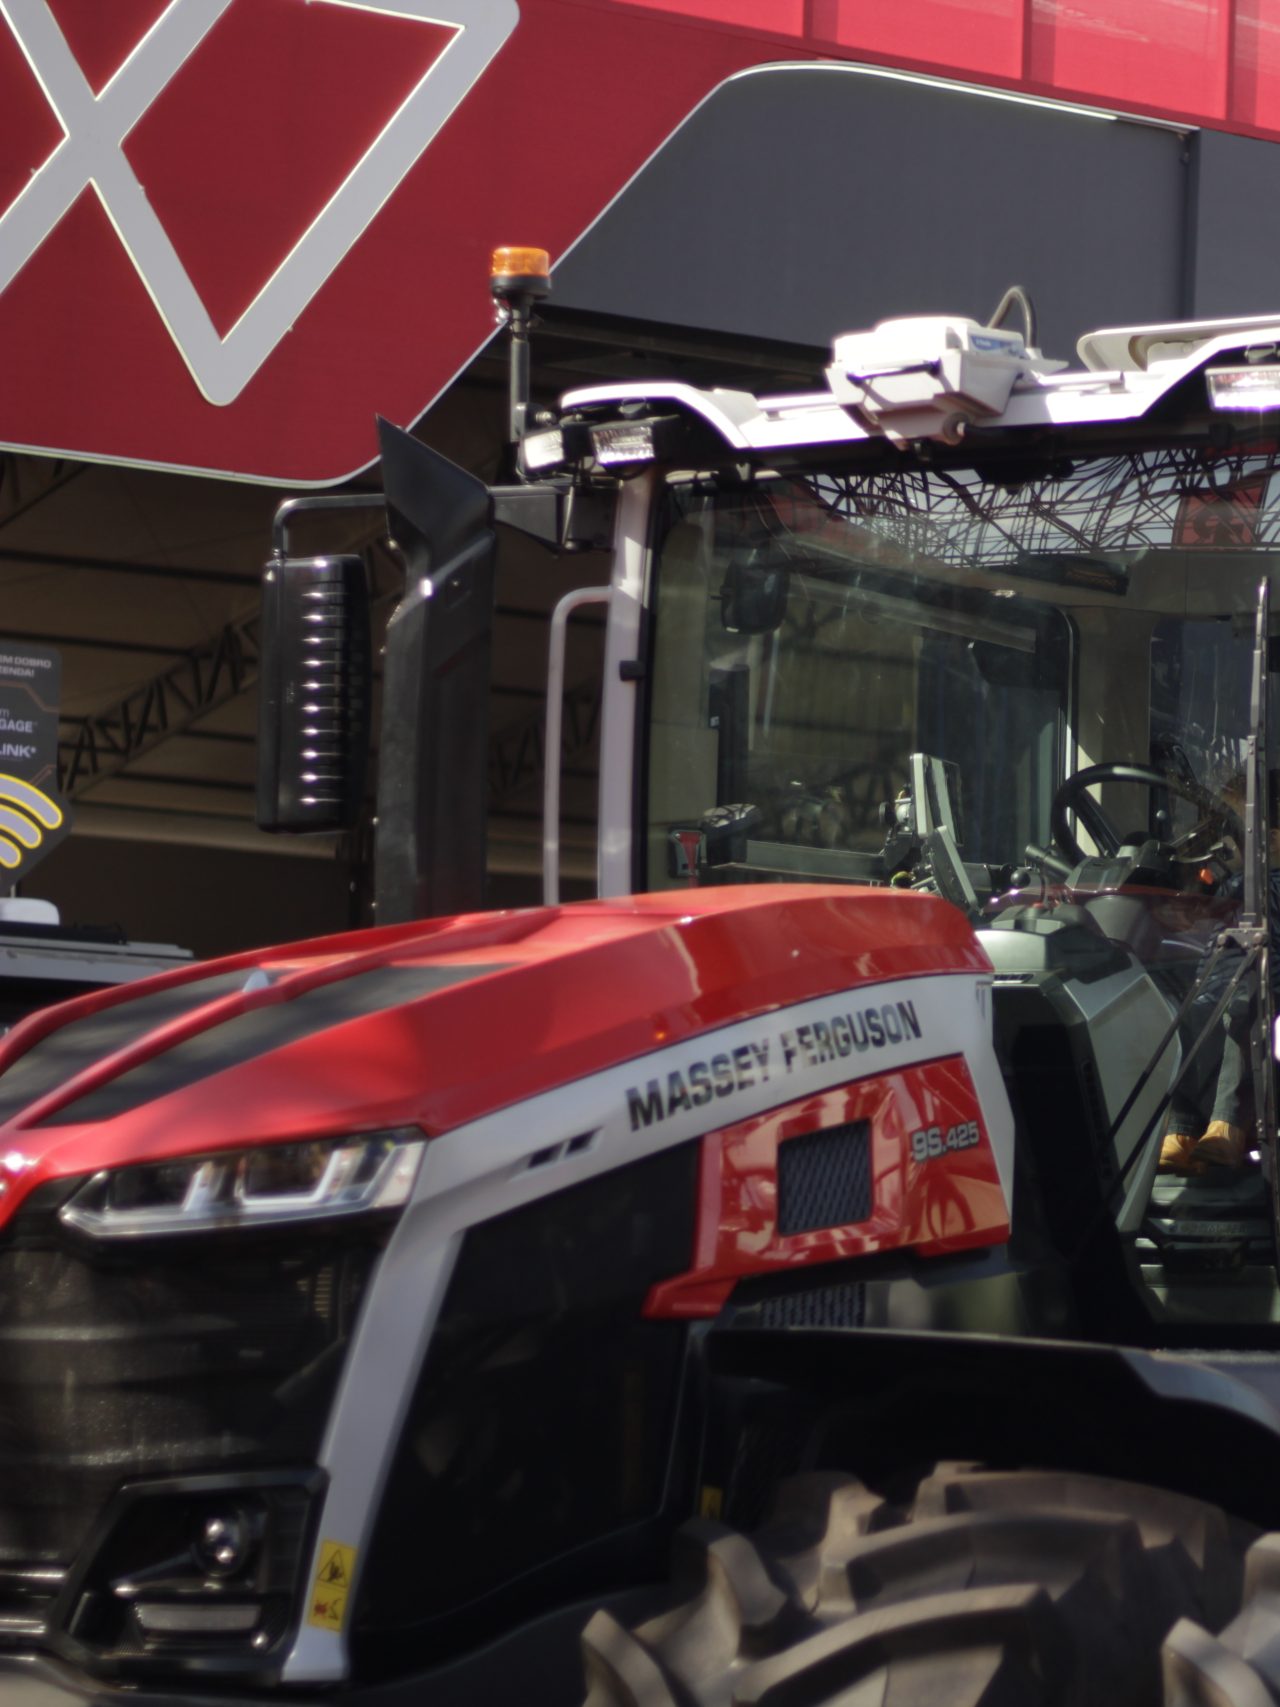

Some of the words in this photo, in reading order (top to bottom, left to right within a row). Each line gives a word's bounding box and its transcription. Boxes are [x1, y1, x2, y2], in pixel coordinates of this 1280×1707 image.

[14, 657, 52, 668] DOBRO
[625, 1038, 769, 1131] MASSEY
[780, 1000, 922, 1073] FERGUSON
